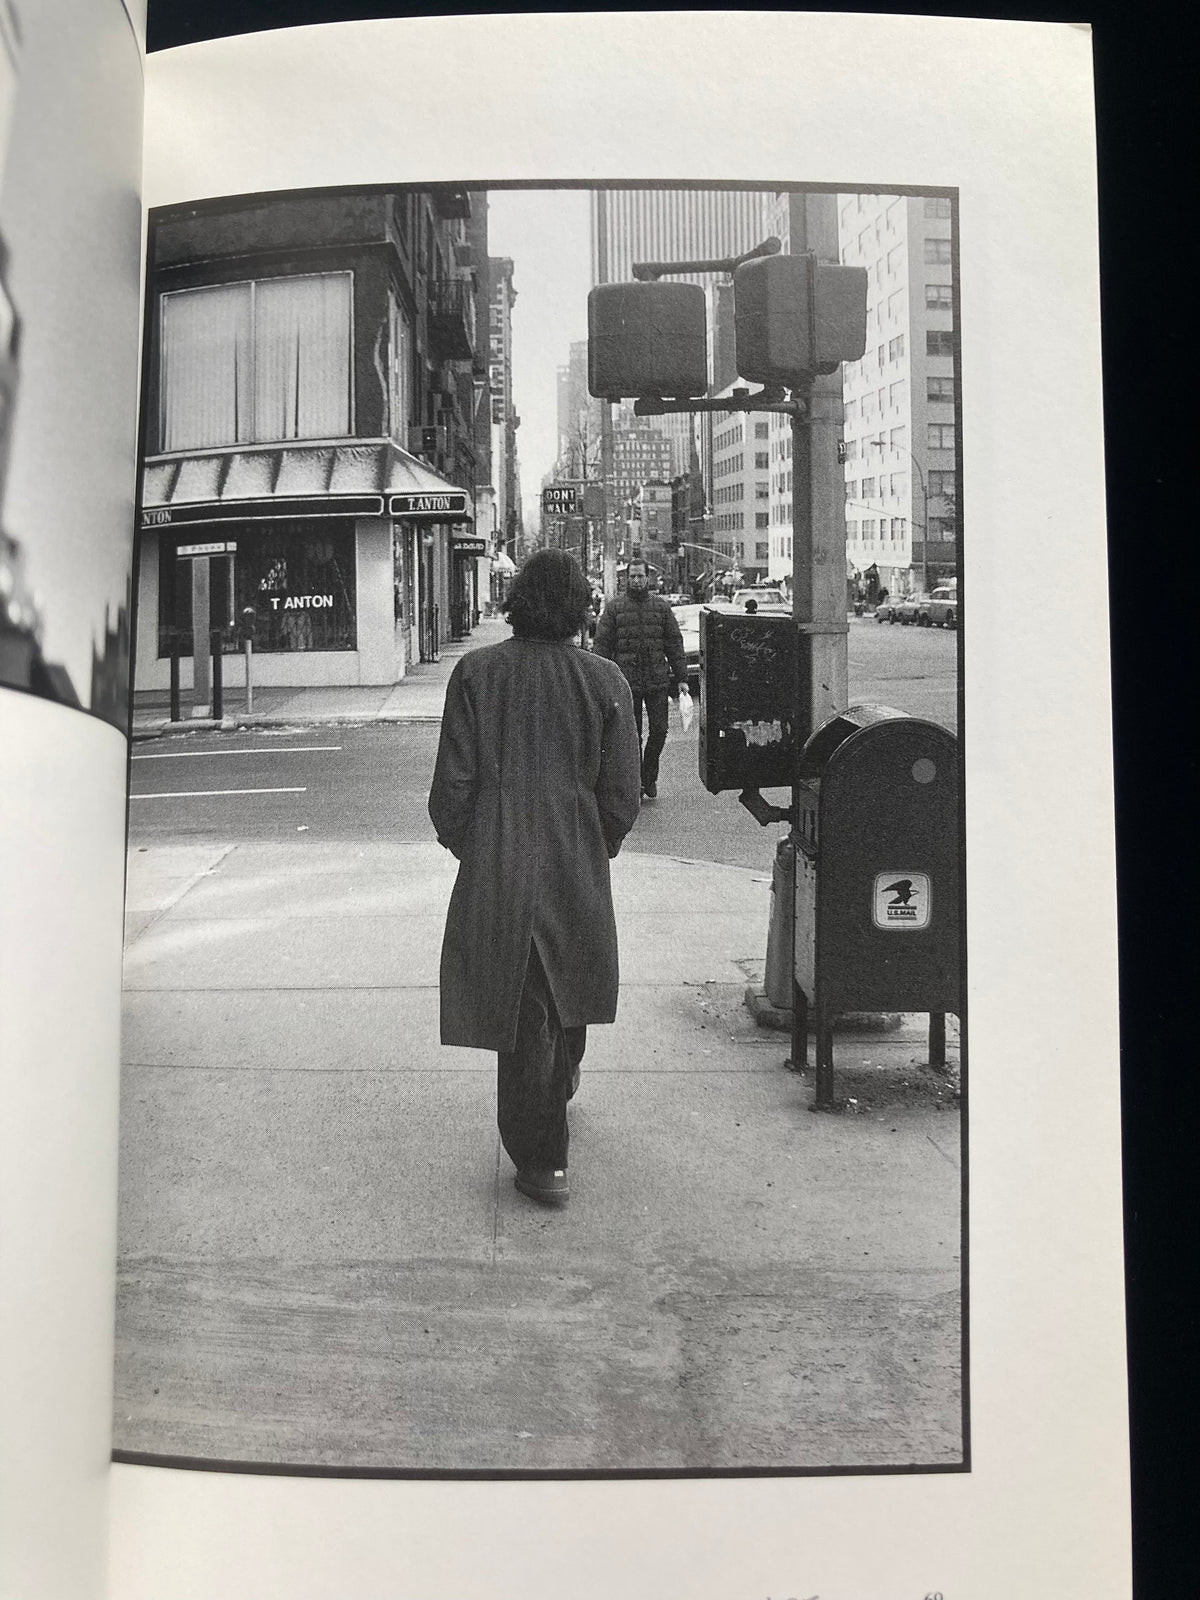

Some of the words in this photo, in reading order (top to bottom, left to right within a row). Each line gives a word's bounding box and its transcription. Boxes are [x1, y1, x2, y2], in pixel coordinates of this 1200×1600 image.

[546, 489, 575, 500] DONT
[547, 503, 575, 513] WALK
[270, 598, 281, 610] T
[284, 595, 333, 609] ANTON
